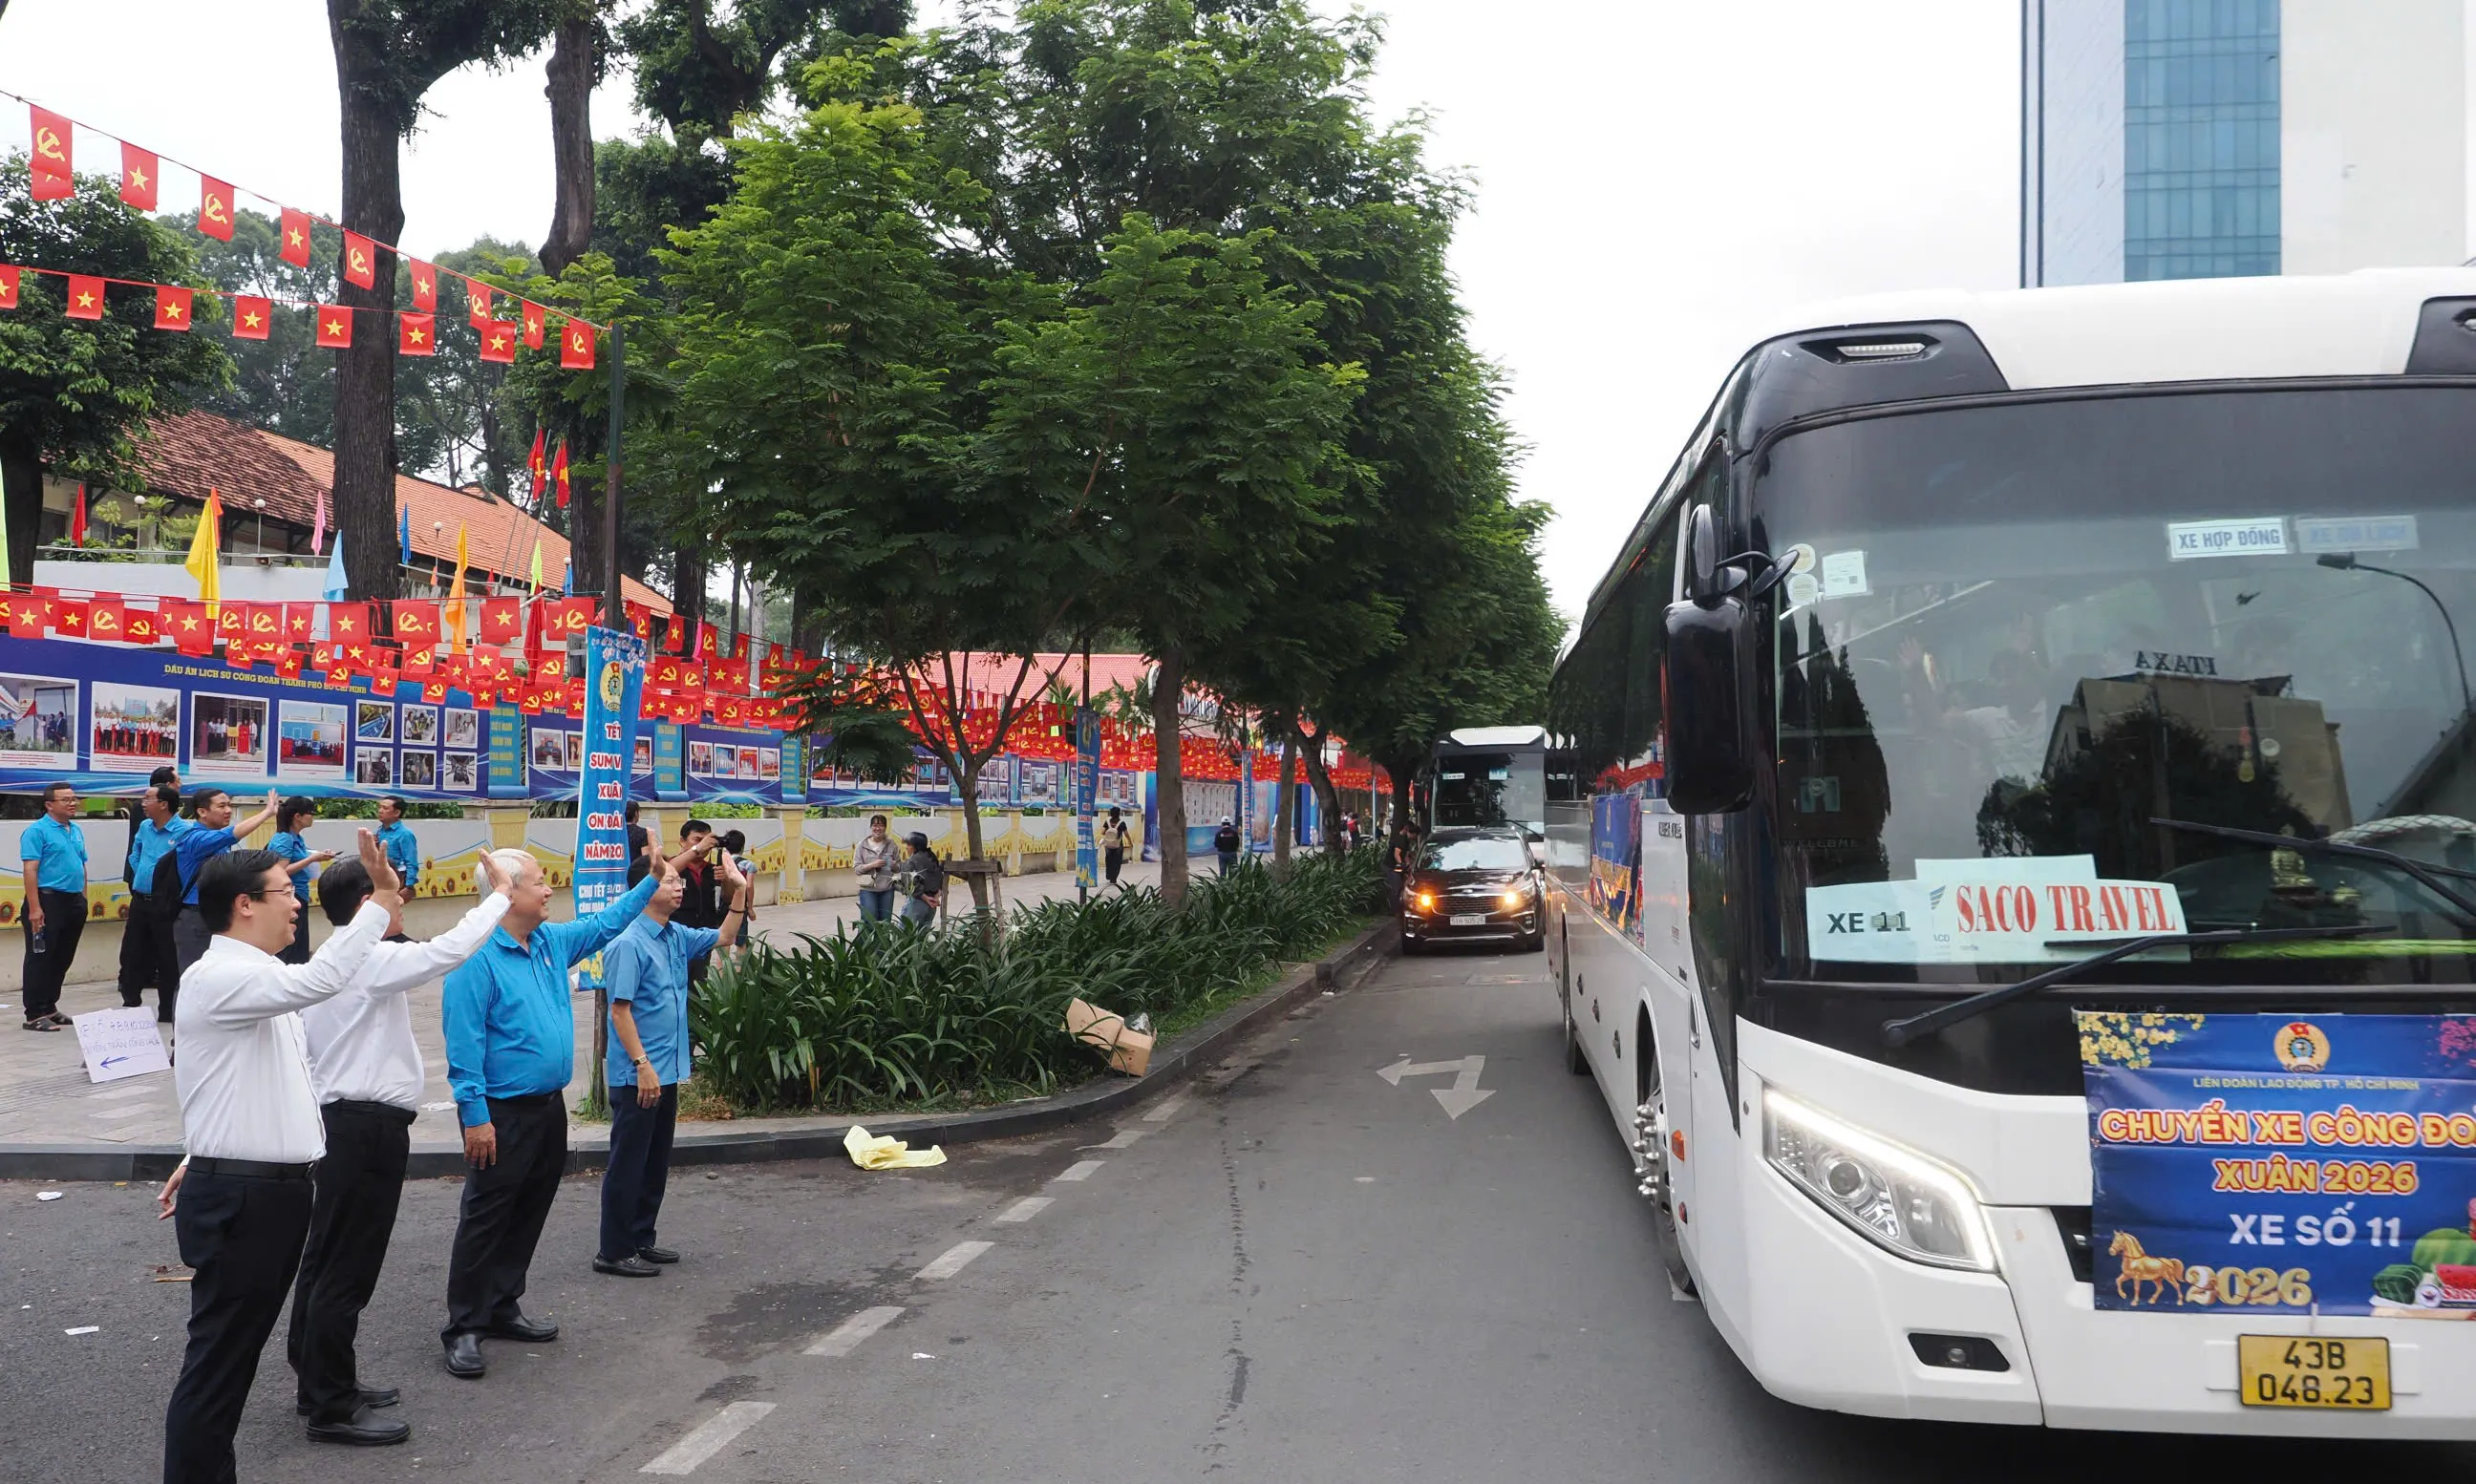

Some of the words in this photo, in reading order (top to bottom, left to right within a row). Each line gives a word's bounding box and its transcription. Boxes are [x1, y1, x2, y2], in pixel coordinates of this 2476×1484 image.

[2178, 533, 2197, 549] XE
[2203, 531, 2232, 550] HỢP
[2238, 526, 2281, 546] ĐỒNG
[232, 671, 256, 684] CÔNG
[606, 721, 622, 739] TẾT
[590, 753, 613, 770] SUM
[588, 812, 605, 829] ƠN
[607, 810, 623, 829] ĐẢ
[585, 840, 609, 859] NĂM
[609, 842, 625, 859] 20
[1827, 912, 1865, 934] XE
[1874, 911, 1910, 933] 11
[1956, 884, 2038, 933] SACO
[2045, 884, 2177, 933] TRAVEL
[2192, 1076, 2221, 1088] LIÊN
[2222, 1077, 2257, 1089] ĐOÀN
[2258, 1079, 2285, 1089] LAO
[2286, 1078, 2322, 1091] ĐỘNG
[2345, 1077, 2364, 1090] HỒ
[2365, 1078, 2386, 1090] CHÍ
[2387, 1080, 2419, 1091] MINH
[2100, 1099, 2249, 1143] CHUYẾN
[2255, 1113, 2305, 1144] XE
[2309, 1105, 2417, 1146] CÔNG
[2213, 1154, 2318, 1192] XUÂN
[2323, 1160, 2417, 1194] 2026
[2229, 1214, 2285, 1246] XE
[2295, 1201, 2357, 1247] SỐ
[2366, 1217, 2401, 1247] 11
[2185, 1264, 2312, 1307] 2026
[2284, 1340, 2346, 1370] 43B
[2258, 1373, 2375, 1405] 048.23
